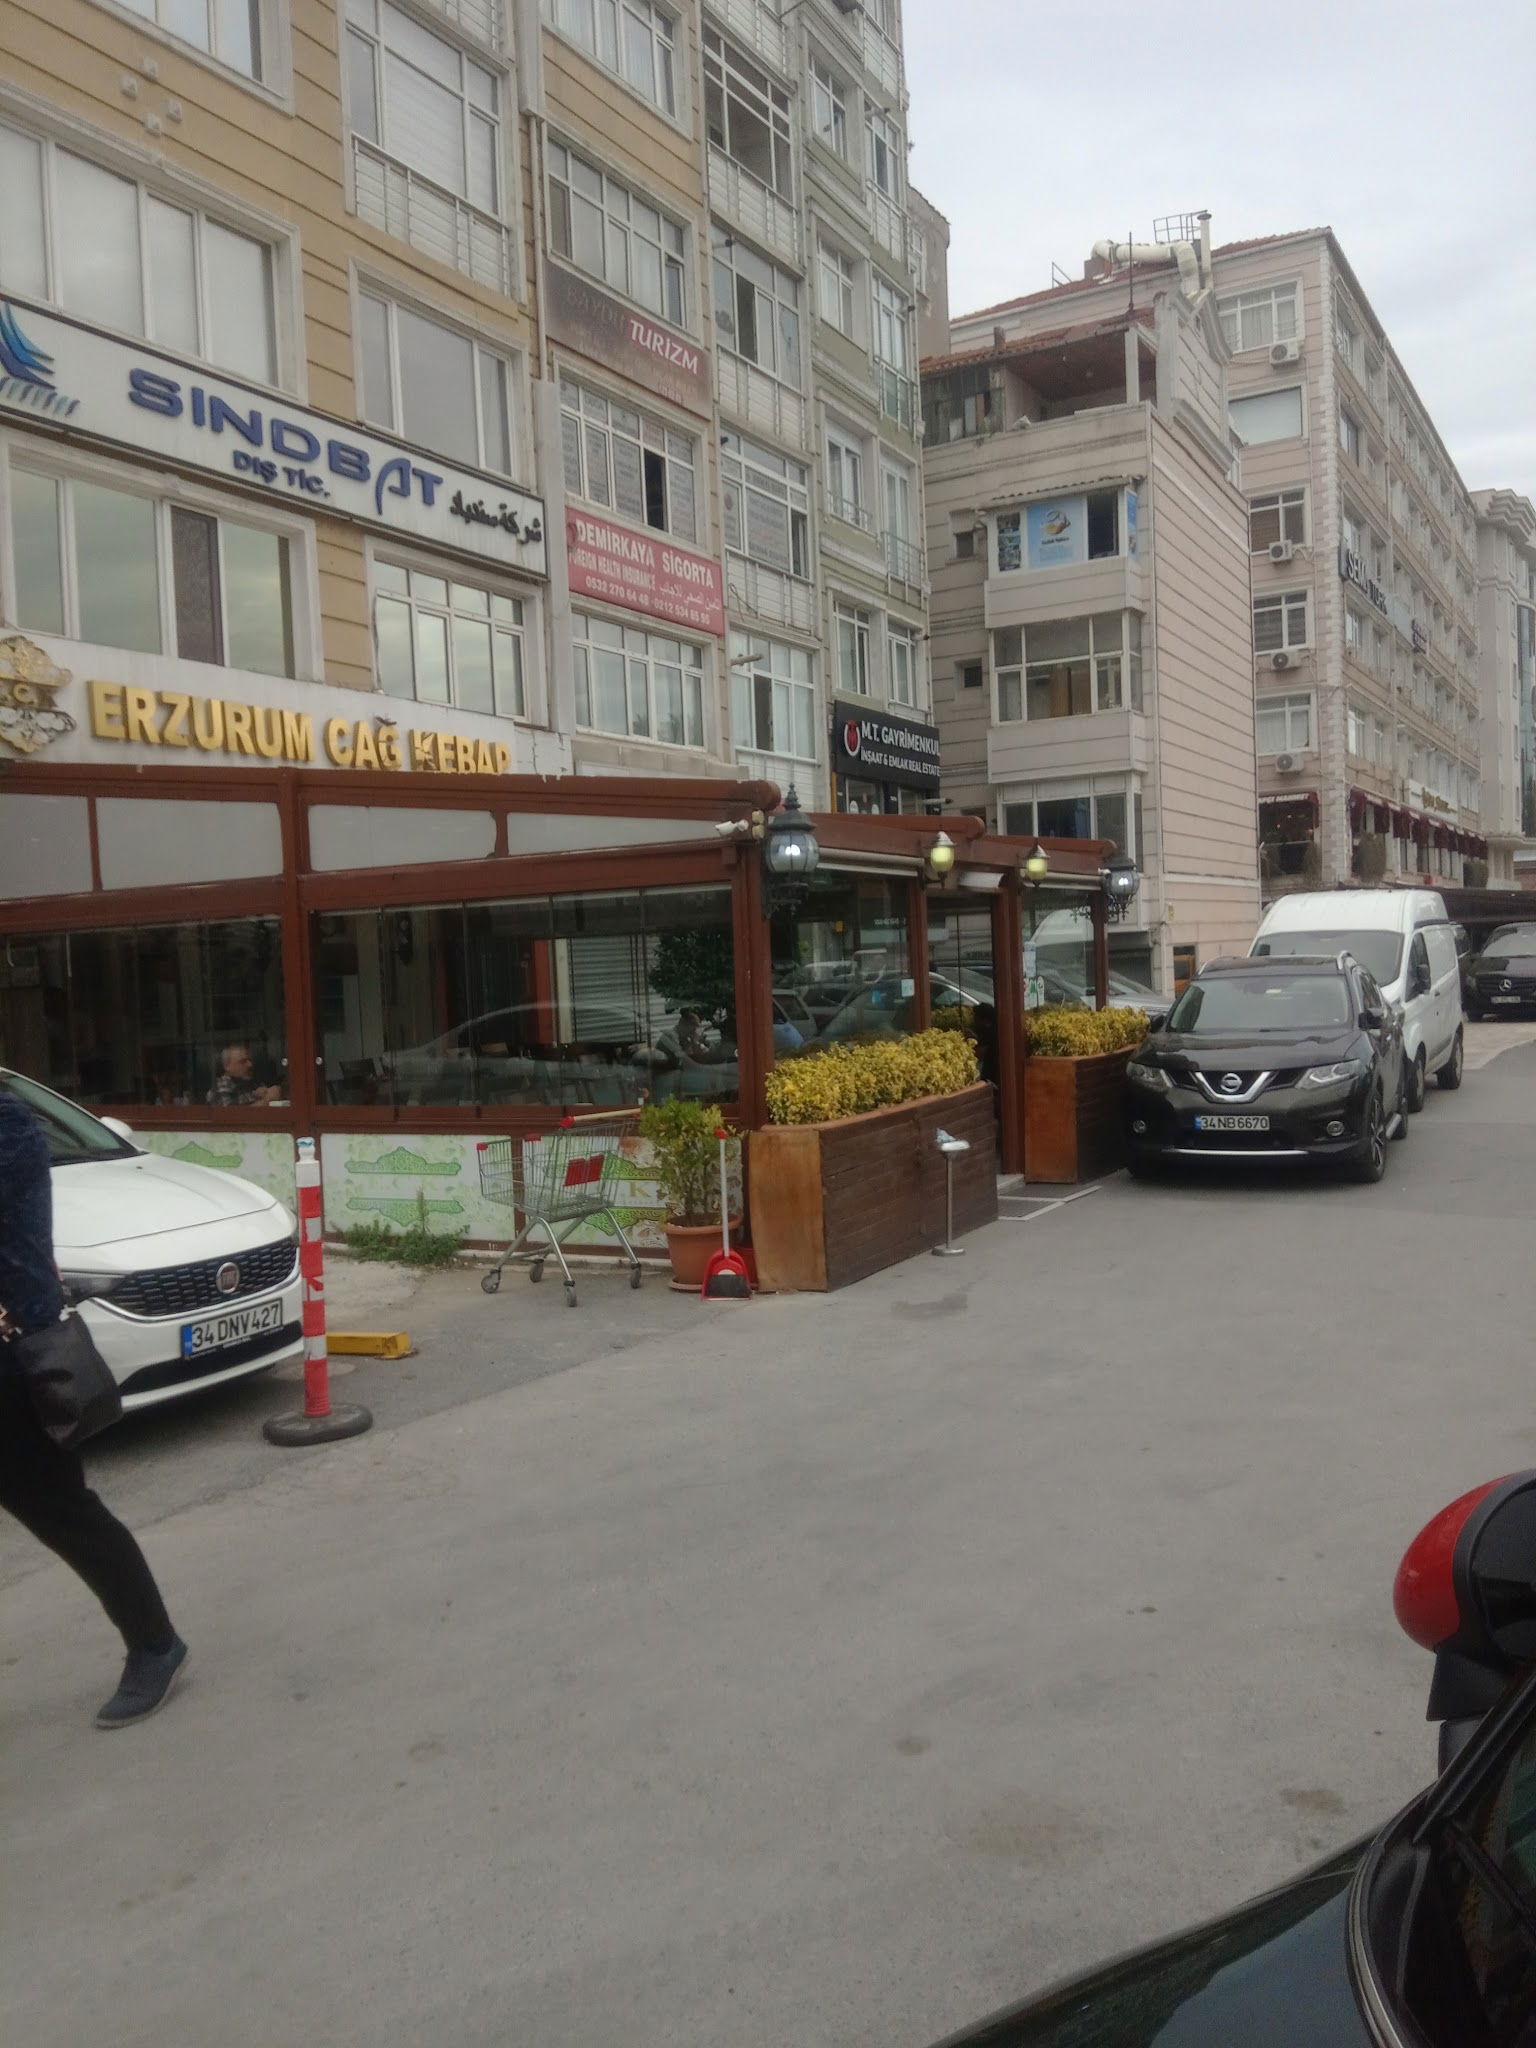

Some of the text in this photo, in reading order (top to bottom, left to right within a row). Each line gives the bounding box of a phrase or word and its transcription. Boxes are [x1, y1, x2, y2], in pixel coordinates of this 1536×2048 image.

[629, 319, 699, 375] TURİZM
[128, 367, 444, 515] SINDBAT
[232, 450, 279, 483] DIŞ
[575, 518, 655, 568] DEMİRKAYA
[662, 550, 714, 589] SİGORTA
[585, 576, 608, 594] 0532
[87, 679, 316, 762] ERZURUM
[409, 728, 512, 775] KEBAP
[881, 726, 941, 756] GAYRİMENKUL
[922, 762, 941, 776] ESTATE
[192, 1323, 215, 1348] 34
[218, 1311, 250, 1341] DNV
[252, 1304, 279, 1329] 427
